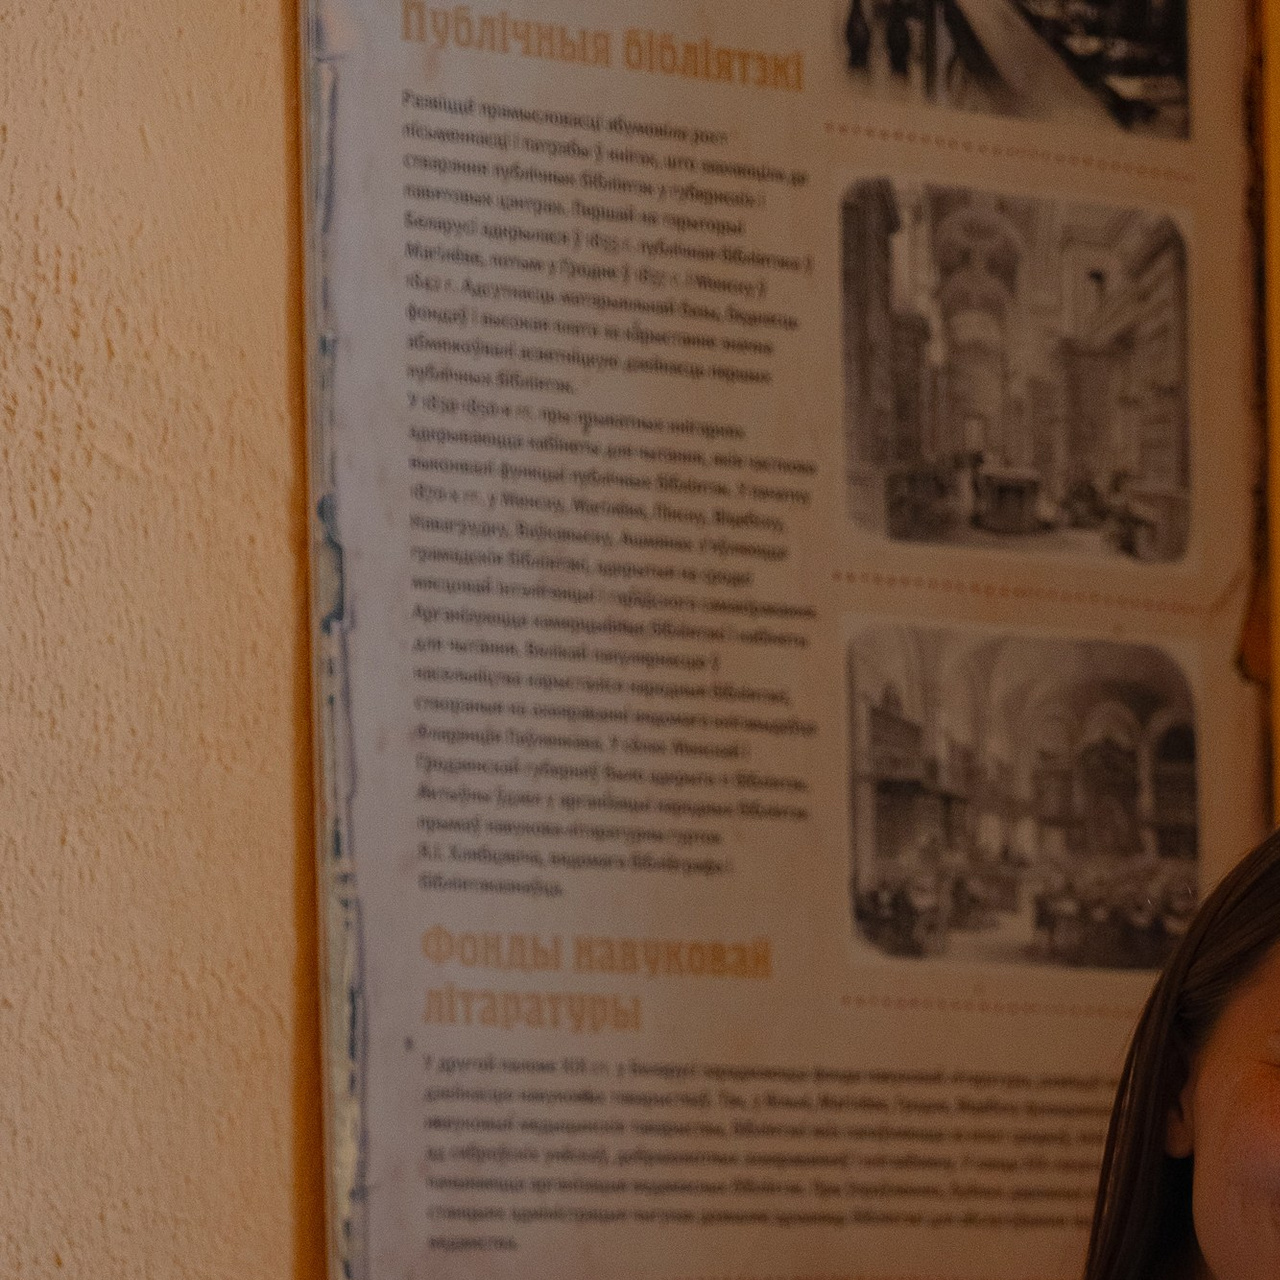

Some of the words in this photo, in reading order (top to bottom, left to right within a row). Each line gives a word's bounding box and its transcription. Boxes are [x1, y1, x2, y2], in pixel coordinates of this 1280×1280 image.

[401, 0, 610, 68] Публічныя
[623, 29, 803, 92] бібліятэкі
[421, 925, 562, 971] Фонды
[572, 936, 773, 978] навуковай
[423, 984, 642, 1033] літаратуры
